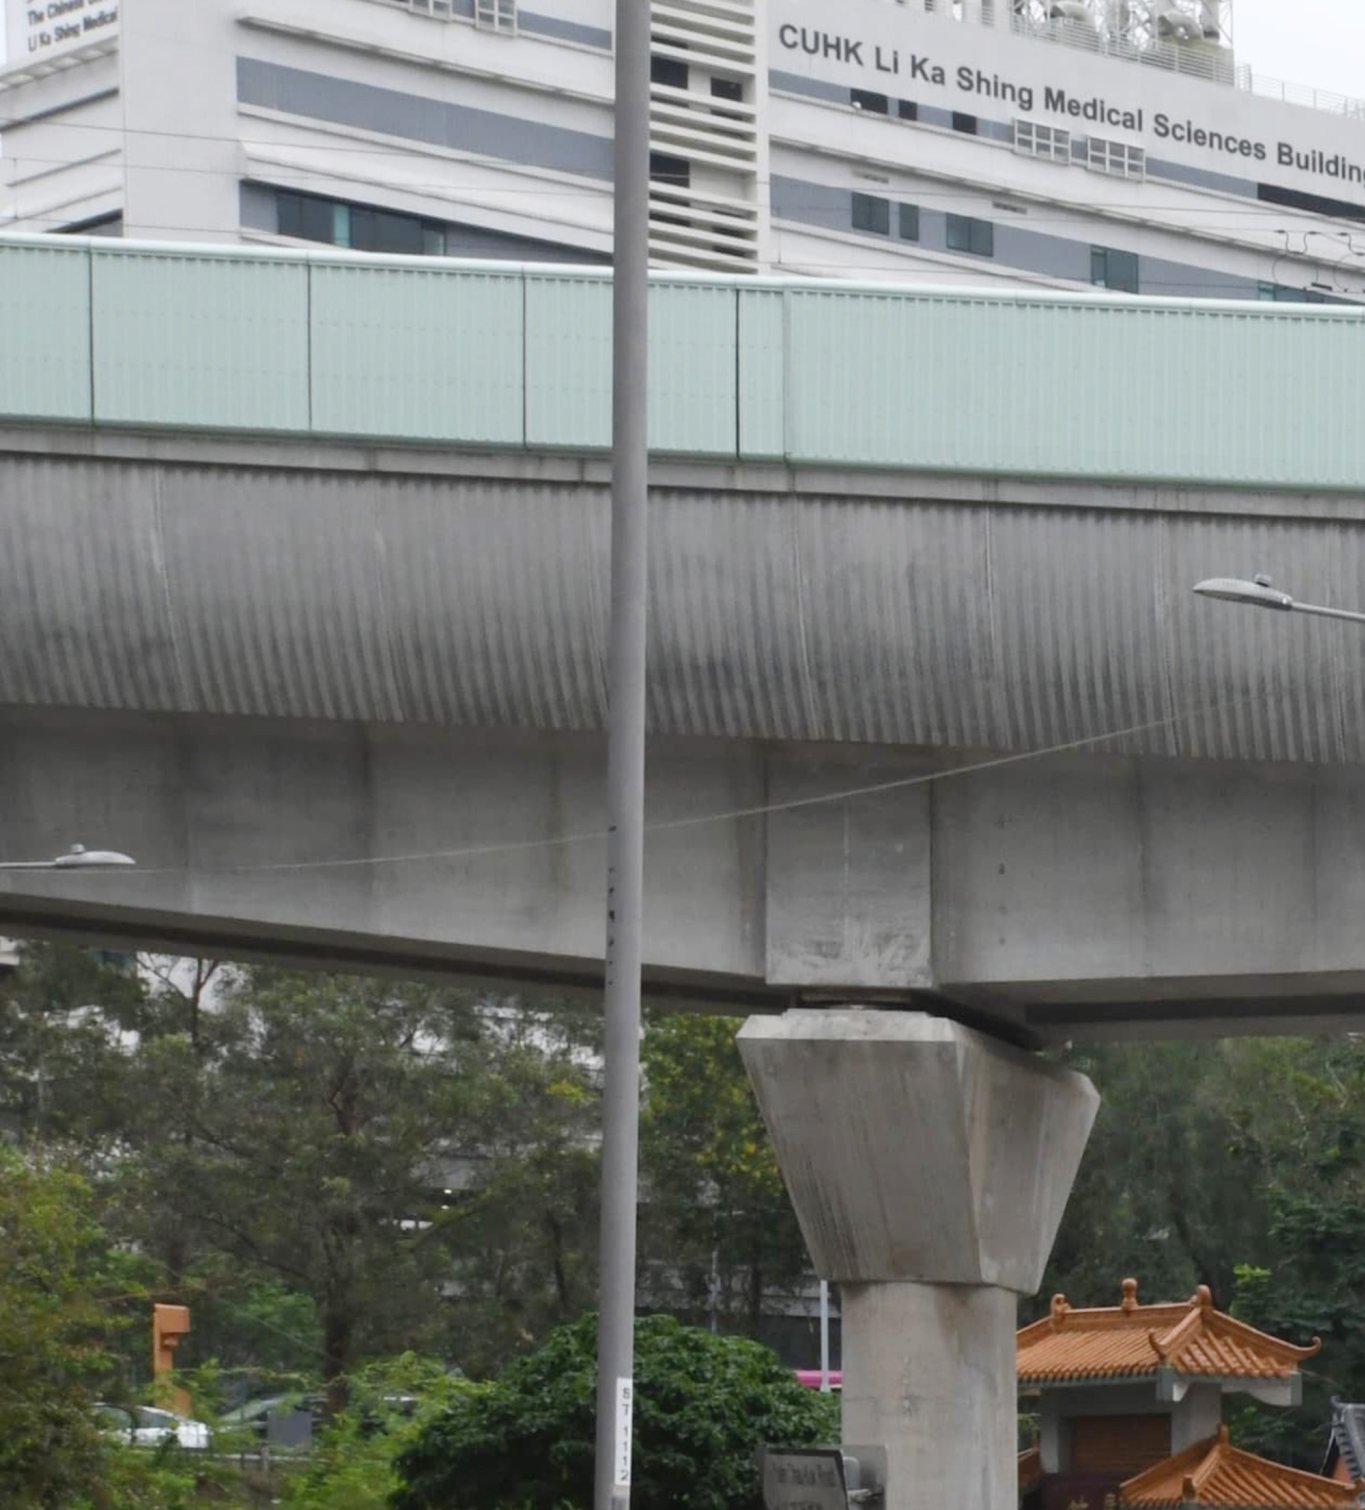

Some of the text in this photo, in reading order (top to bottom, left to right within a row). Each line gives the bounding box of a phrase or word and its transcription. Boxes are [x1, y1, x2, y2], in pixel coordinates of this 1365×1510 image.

[778, 24, 864, 67] CUHK
[875, 46, 899, 75] Li
[911, 55, 946, 86] Ka
[957, 66, 1034, 111] Shing
[1044, 86, 1143, 132] Medical
[1153, 113, 1266, 161] Sciences
